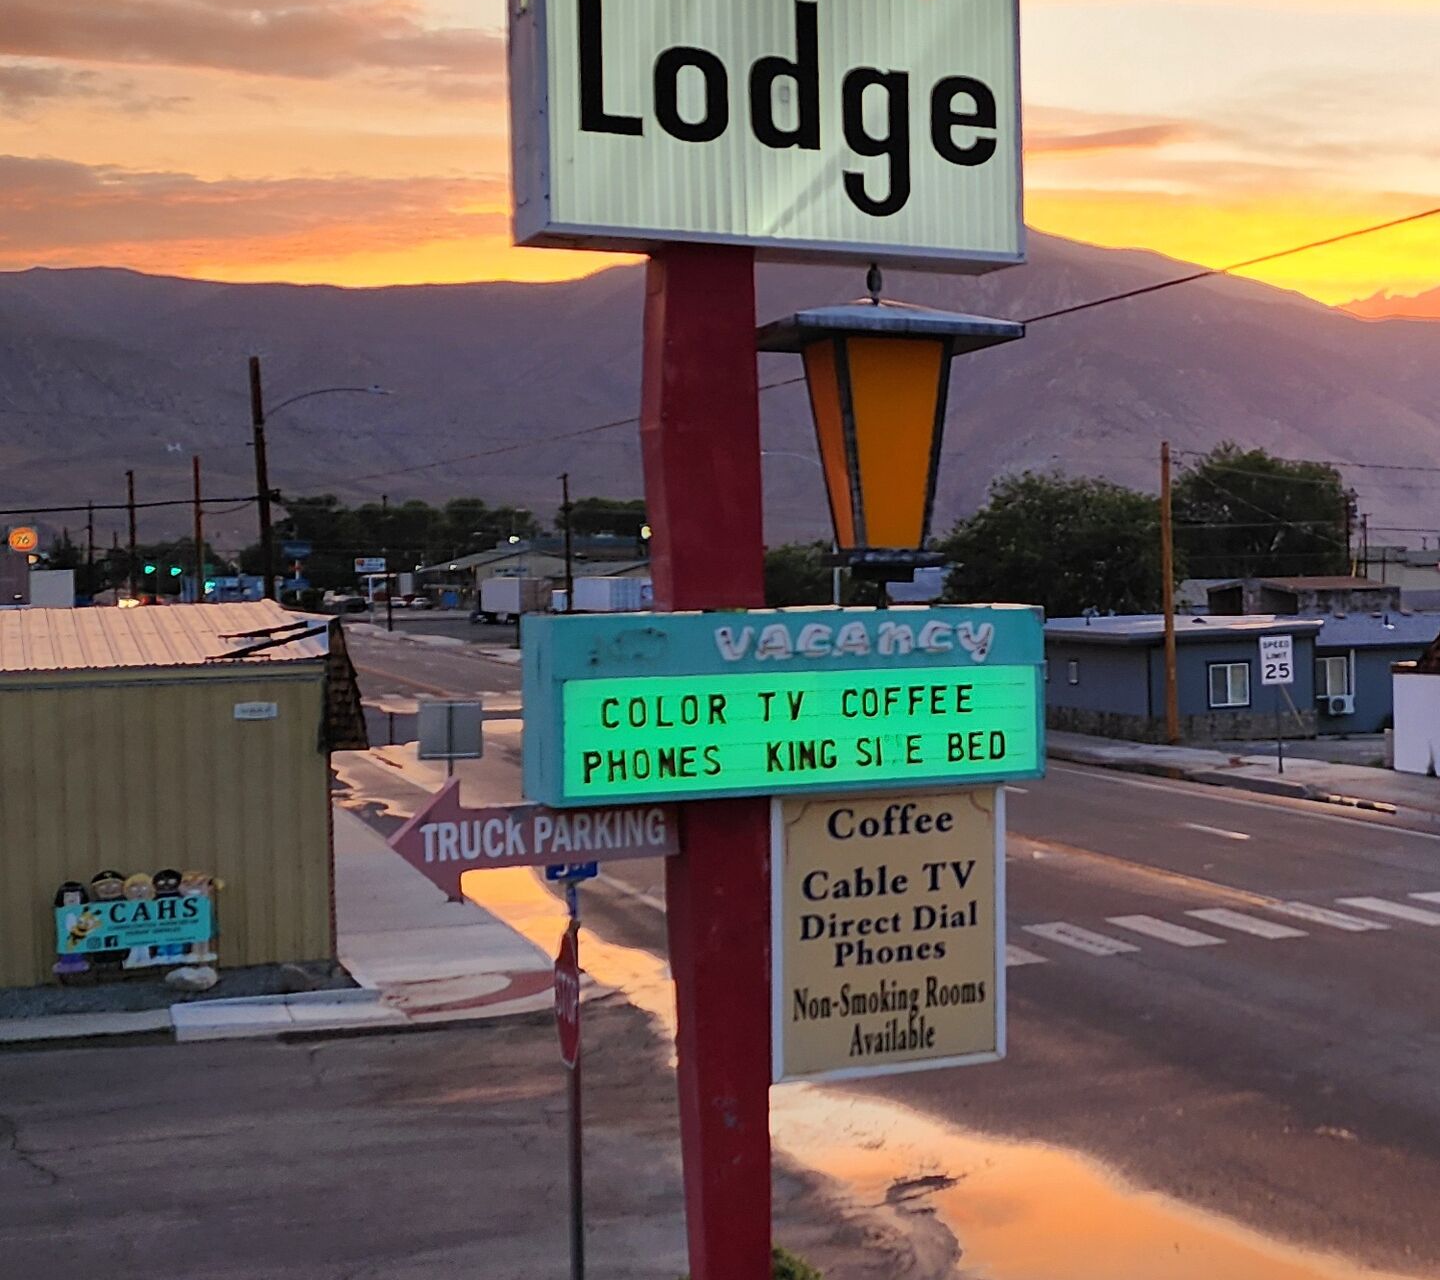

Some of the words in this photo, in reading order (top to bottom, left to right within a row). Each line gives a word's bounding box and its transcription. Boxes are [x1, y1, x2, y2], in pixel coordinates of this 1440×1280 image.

[1265, 662, 1290, 679] 25
[601, 692, 728, 728] COLOR
[757, 690, 805, 722] TV
[841, 683, 974, 718] COFFEE
[583, 744, 721, 784] PHONES
[766, 738, 838, 772] KING
[948, 730, 1006, 762] BED
[419, 815, 527, 863] TRUCK
[533, 808, 666, 855] PARKING
[827, 803, 954, 840] Coffee
[802, 864, 909, 902] Cable
[922, 860, 977, 892] TV
[109, 897, 199, 924] CAHS
[800, 911, 902, 941] Direct
[912, 900, 978, 931] Dial
[833, 938, 947, 968] Phones
[792, 978, 920, 1022] Non-Smoking
[925, 975, 986, 1009] Rooms
[849, 1015, 936, 1058] Available
